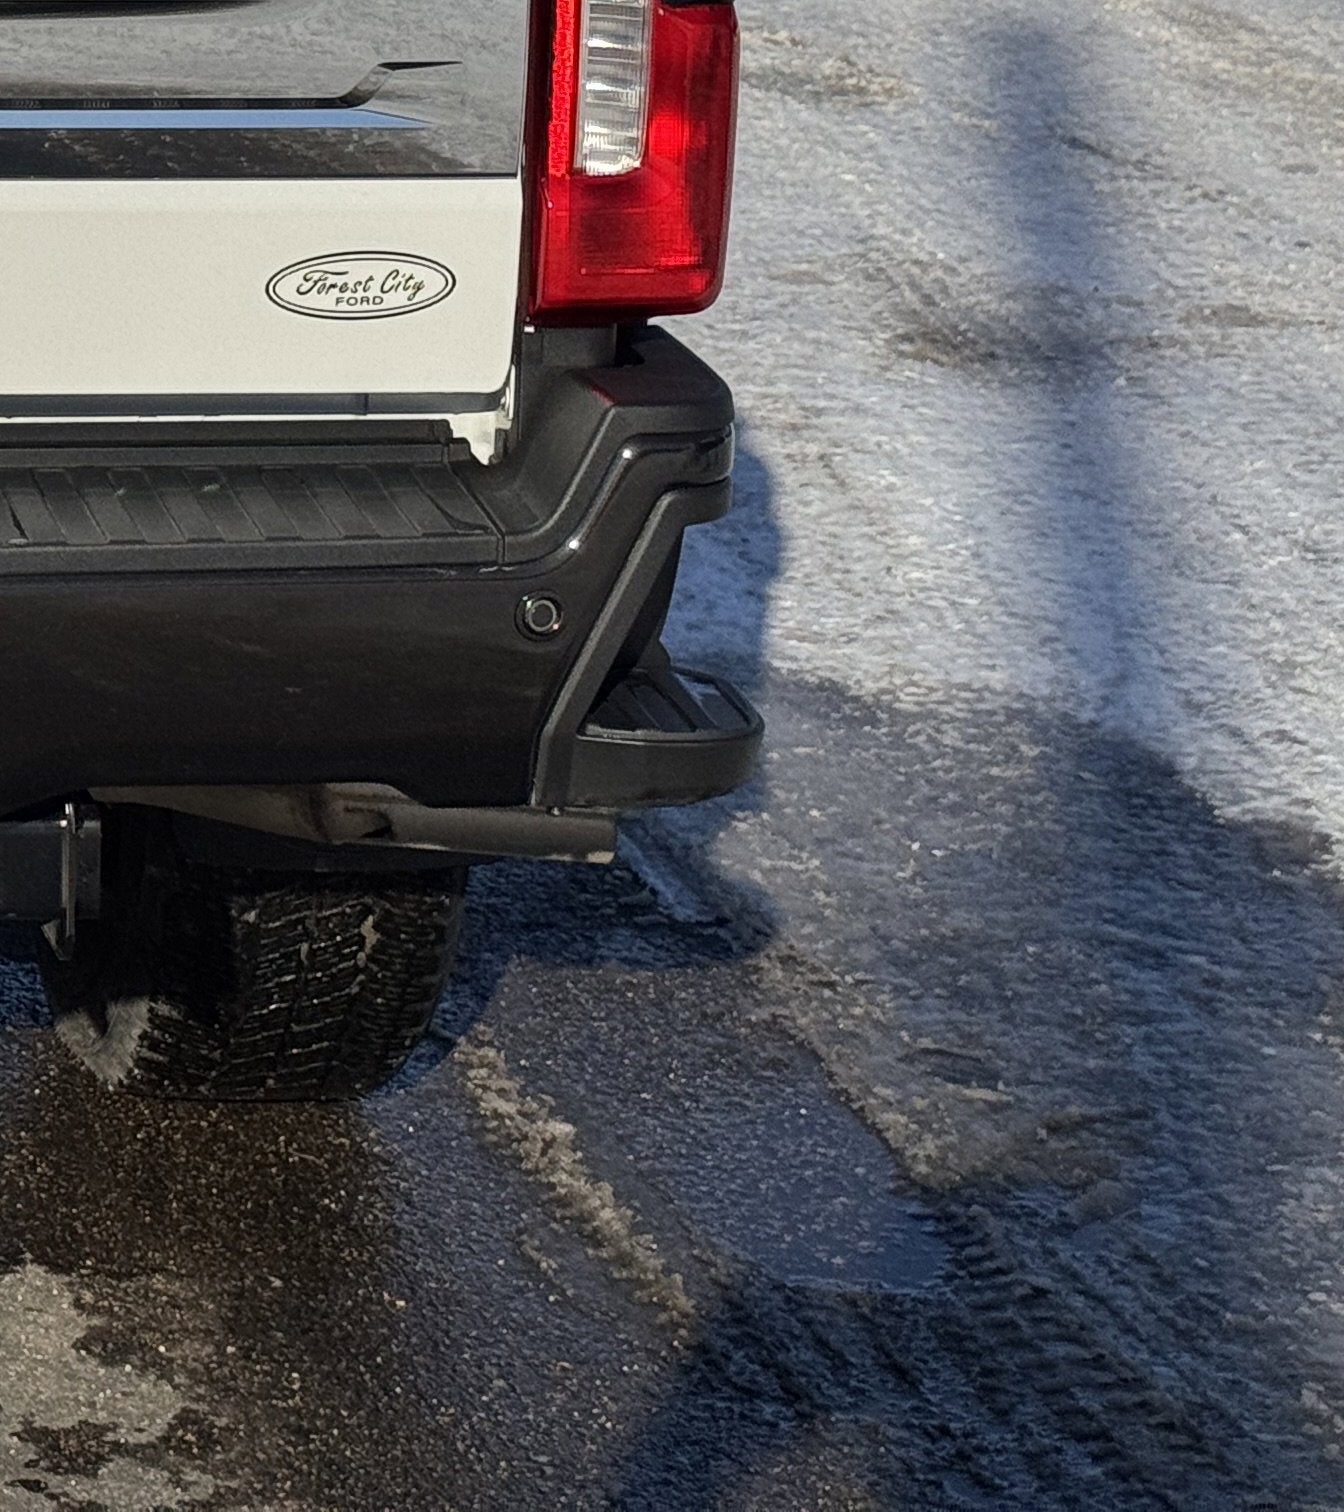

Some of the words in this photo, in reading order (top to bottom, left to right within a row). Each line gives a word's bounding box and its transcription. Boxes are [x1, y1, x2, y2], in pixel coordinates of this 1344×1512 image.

[295, 269, 375, 296] Forest
[379, 268, 426, 302] City
[334, 295, 385, 307] FORD
